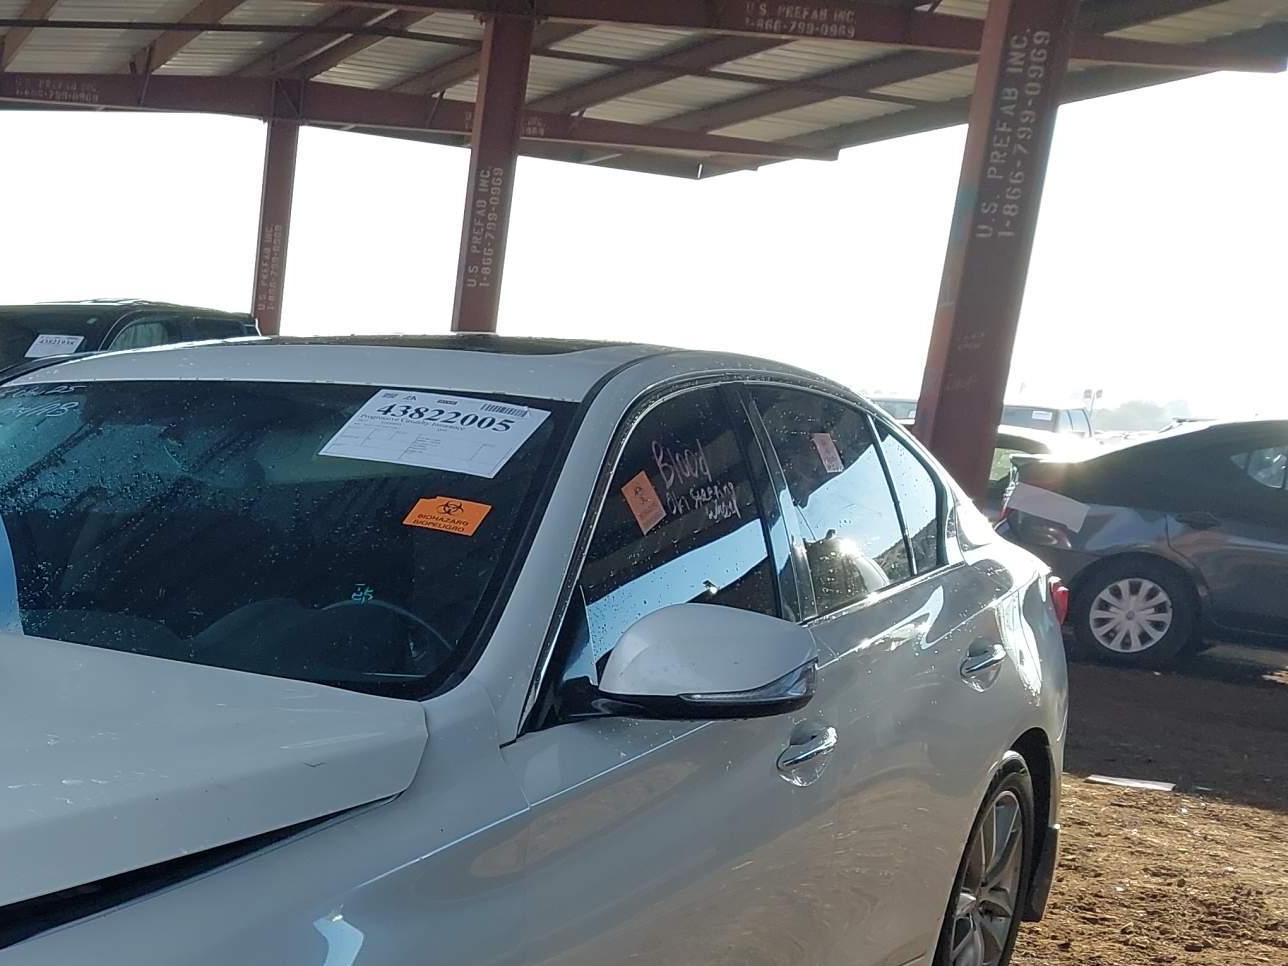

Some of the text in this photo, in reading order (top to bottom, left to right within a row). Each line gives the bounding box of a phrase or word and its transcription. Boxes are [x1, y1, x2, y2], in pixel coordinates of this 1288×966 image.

[987, 87, 1020, 180] PREFAB
[1006, 27, 1032, 73] INC.
[998, 30, 1051, 237] 1-866-799-0969
[471, 199, 488, 254] PREFAB
[479, 167, 504, 287] 1-866-799-0969
[376, 403, 516, 433] 43822005
